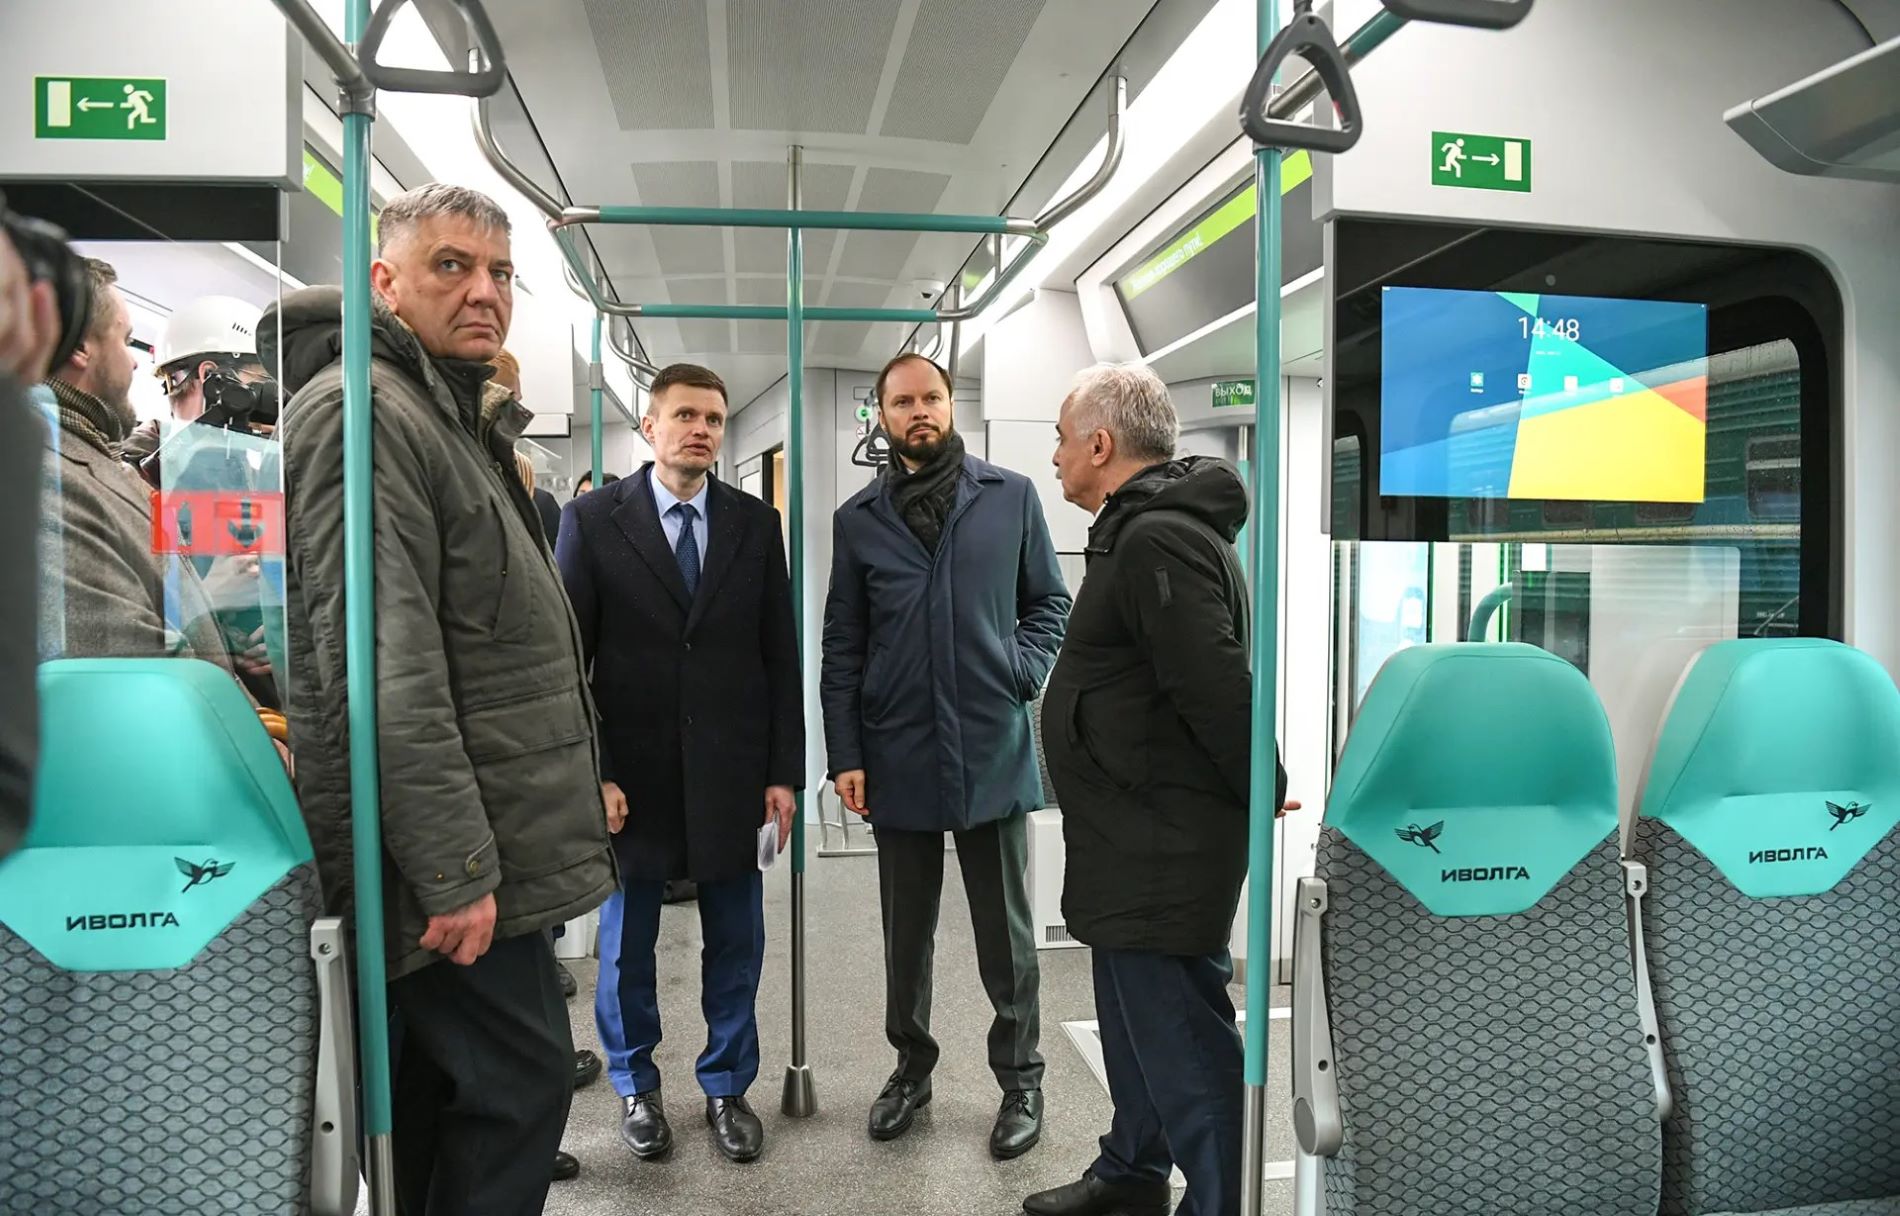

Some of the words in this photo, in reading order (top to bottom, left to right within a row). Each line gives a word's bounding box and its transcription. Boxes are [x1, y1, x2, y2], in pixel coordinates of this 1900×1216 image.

[1518, 316, 1580, 342] 14:48
[1215, 383, 1253, 398] ВЫХОД
[1748, 846, 1829, 864] ИВОЛГА
[1441, 865, 1531, 883] ИВОЛГА
[66, 911, 180, 932] ИВОЛГА
